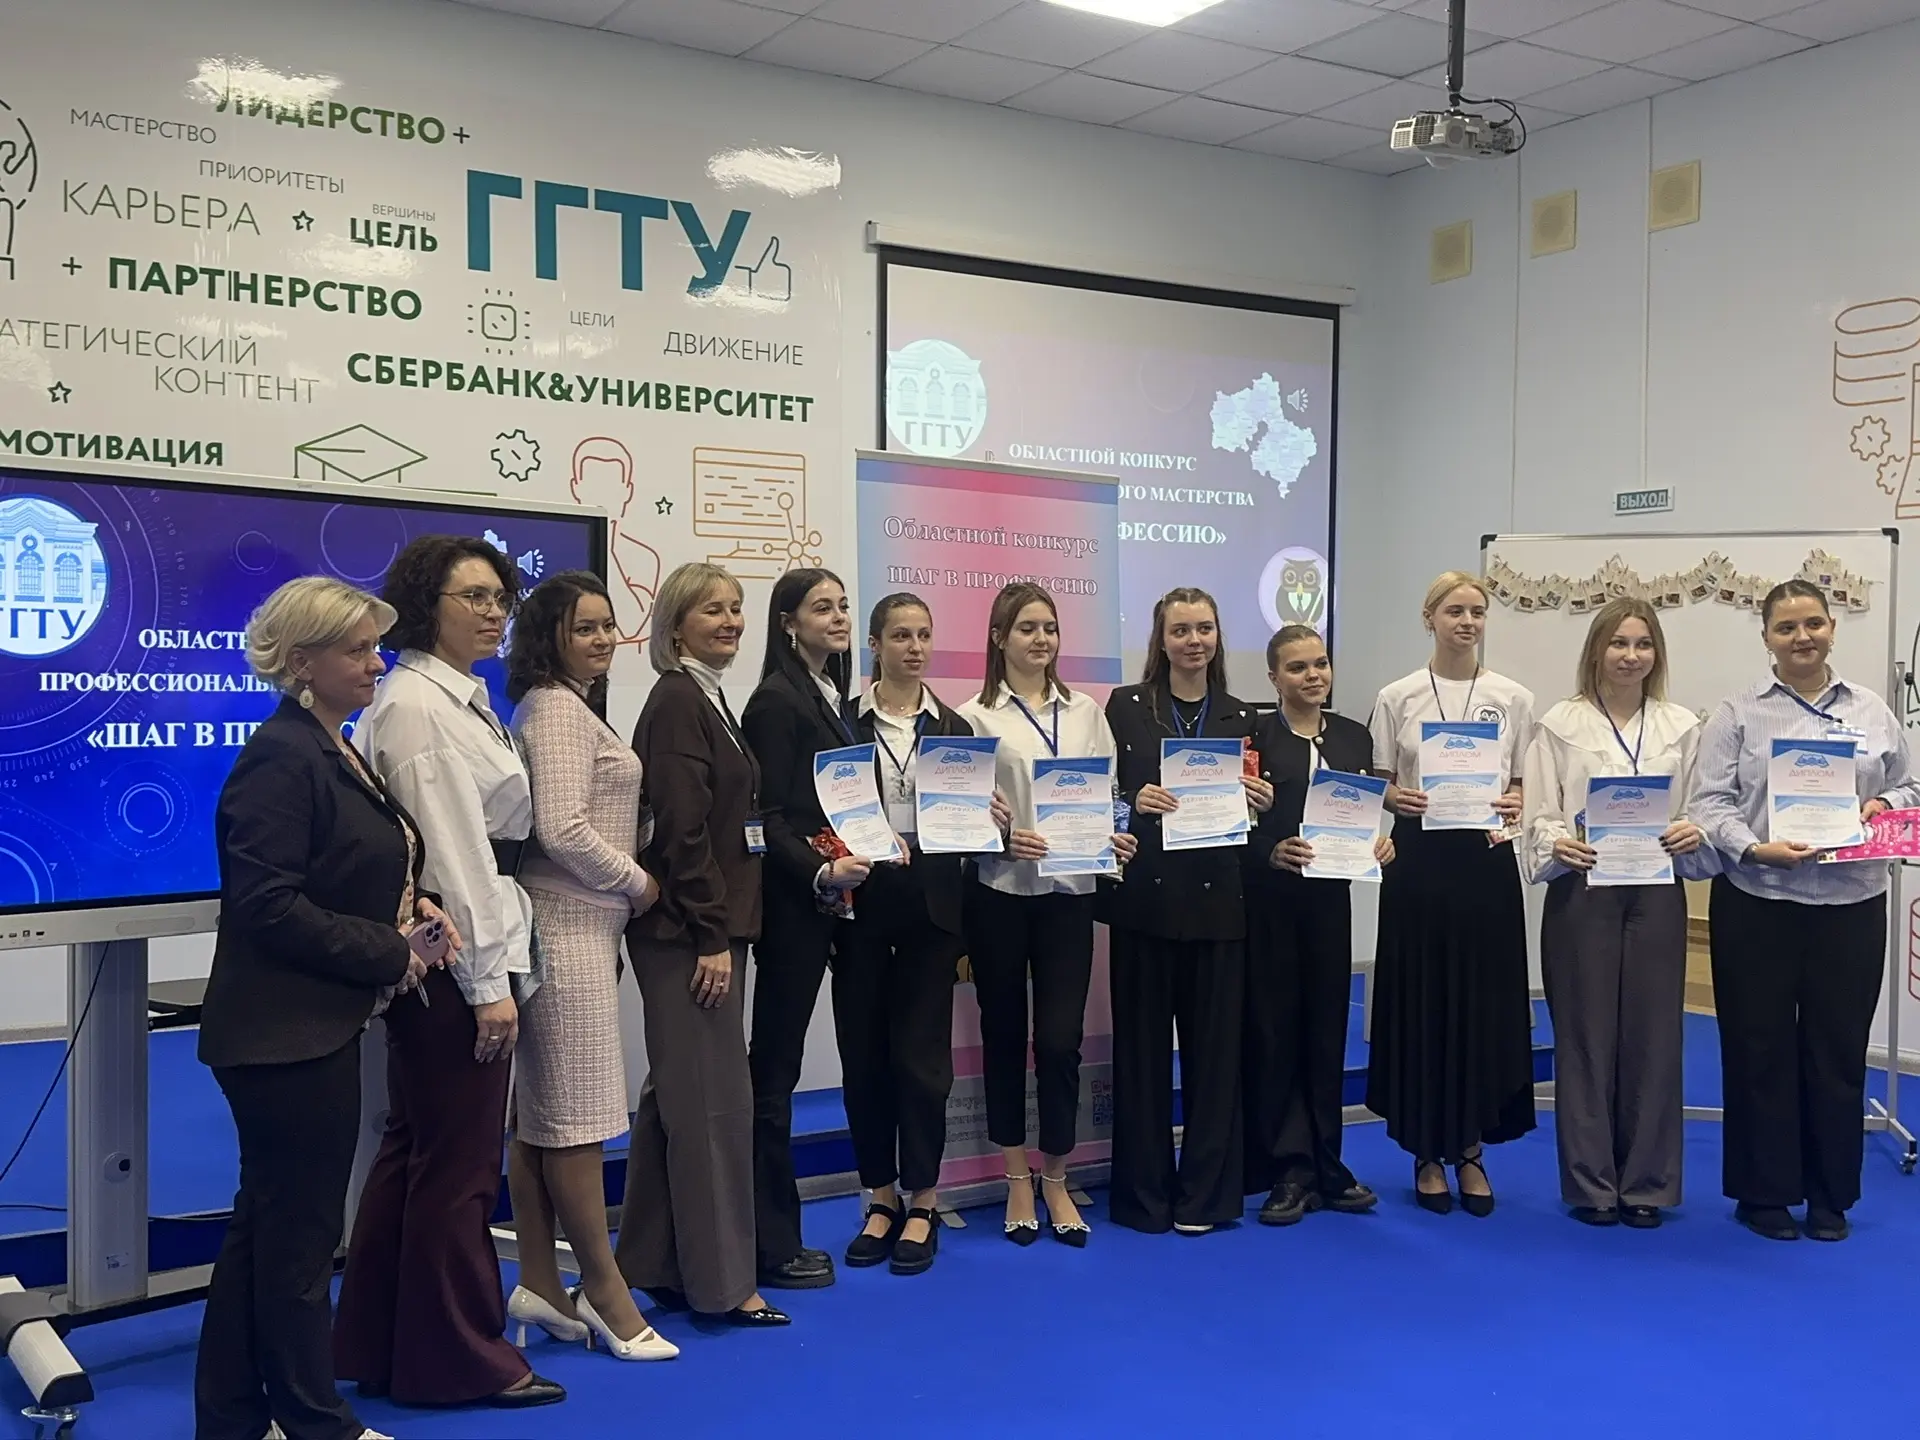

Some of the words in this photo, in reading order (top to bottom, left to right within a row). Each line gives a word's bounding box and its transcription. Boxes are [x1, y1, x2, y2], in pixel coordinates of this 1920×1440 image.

[71, 109, 217, 144] МАСТЕРСТВО
[200, 159, 344, 194] ПРИОРИТЕТЫ
[63, 179, 260, 236] КАРЬЕРА
[372, 203, 436, 222] ВЕРШИНЫ
[350, 217, 438, 252] ЦЕЛЬ
[467, 169, 751, 297] ГГТУ
[109, 257, 422, 320] ПАРТНЕРСТВО
[569, 310, 615, 329] ЦЕЛИ
[664, 331, 804, 366] ДВИЖЕНИЕ
[155, 365, 320, 403] КОНТЕНТ
[346, 352, 814, 423] СБЕРБАНК&УНИВЕРСИТЕТ
[904, 422, 974, 449] ГГТУ
[1008, 442, 1115, 465] ОБЛАСТНОЙ
[1119, 452, 1197, 471] КОНКУРС
[1150, 487, 1255, 506] МАСТЕРСТВА
[1620, 491, 1667, 509] ВЫХОД
[883, 515, 1007, 547] Областной
[1012, 533, 1099, 558] конкурс
[887, 564, 939, 586] ШАГ
[944, 569, 958, 587] В
[0, 607, 87, 640] ГТУ
[40, 671, 284, 693] ПРОФЕССИОНАЛЬ
[87, 722, 185, 748] «ШАГ
[194, 722, 215, 747] В
[934, 765, 976, 775] ДИПЛОМ
[1180, 768, 1223, 777] ДИПЛОМ
[1050, 787, 1092, 797] ДИПЛОМ
[1324, 797, 1364, 812] ДИПЛОМ
[935, 805, 979, 813] СЕРТИФИКАТ
